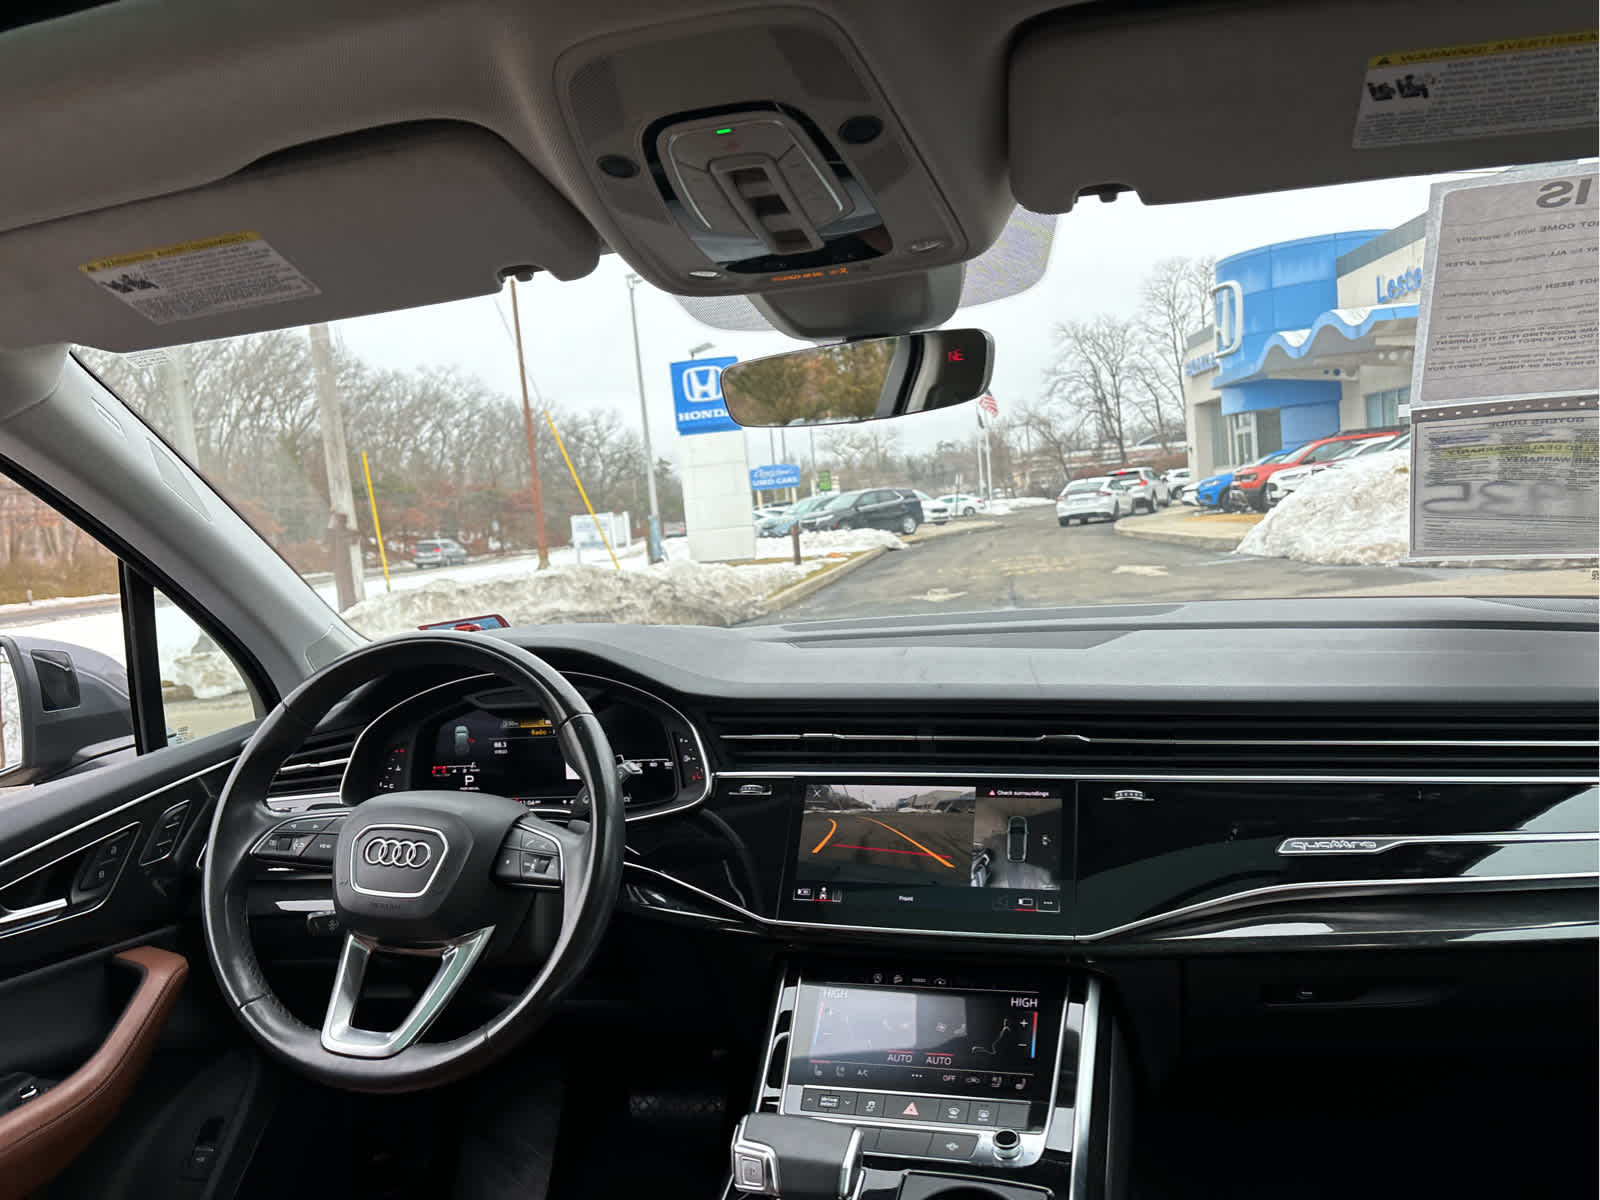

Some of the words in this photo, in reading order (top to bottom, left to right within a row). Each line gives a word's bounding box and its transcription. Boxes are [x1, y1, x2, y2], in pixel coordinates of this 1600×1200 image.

[464, 775, 475, 786] P
[1291, 839, 1377, 851] quattro
[1010, 996, 1039, 1008] HIGH
[887, 1053, 913, 1063] AUTO
[926, 1055, 953, 1066] AUTO
